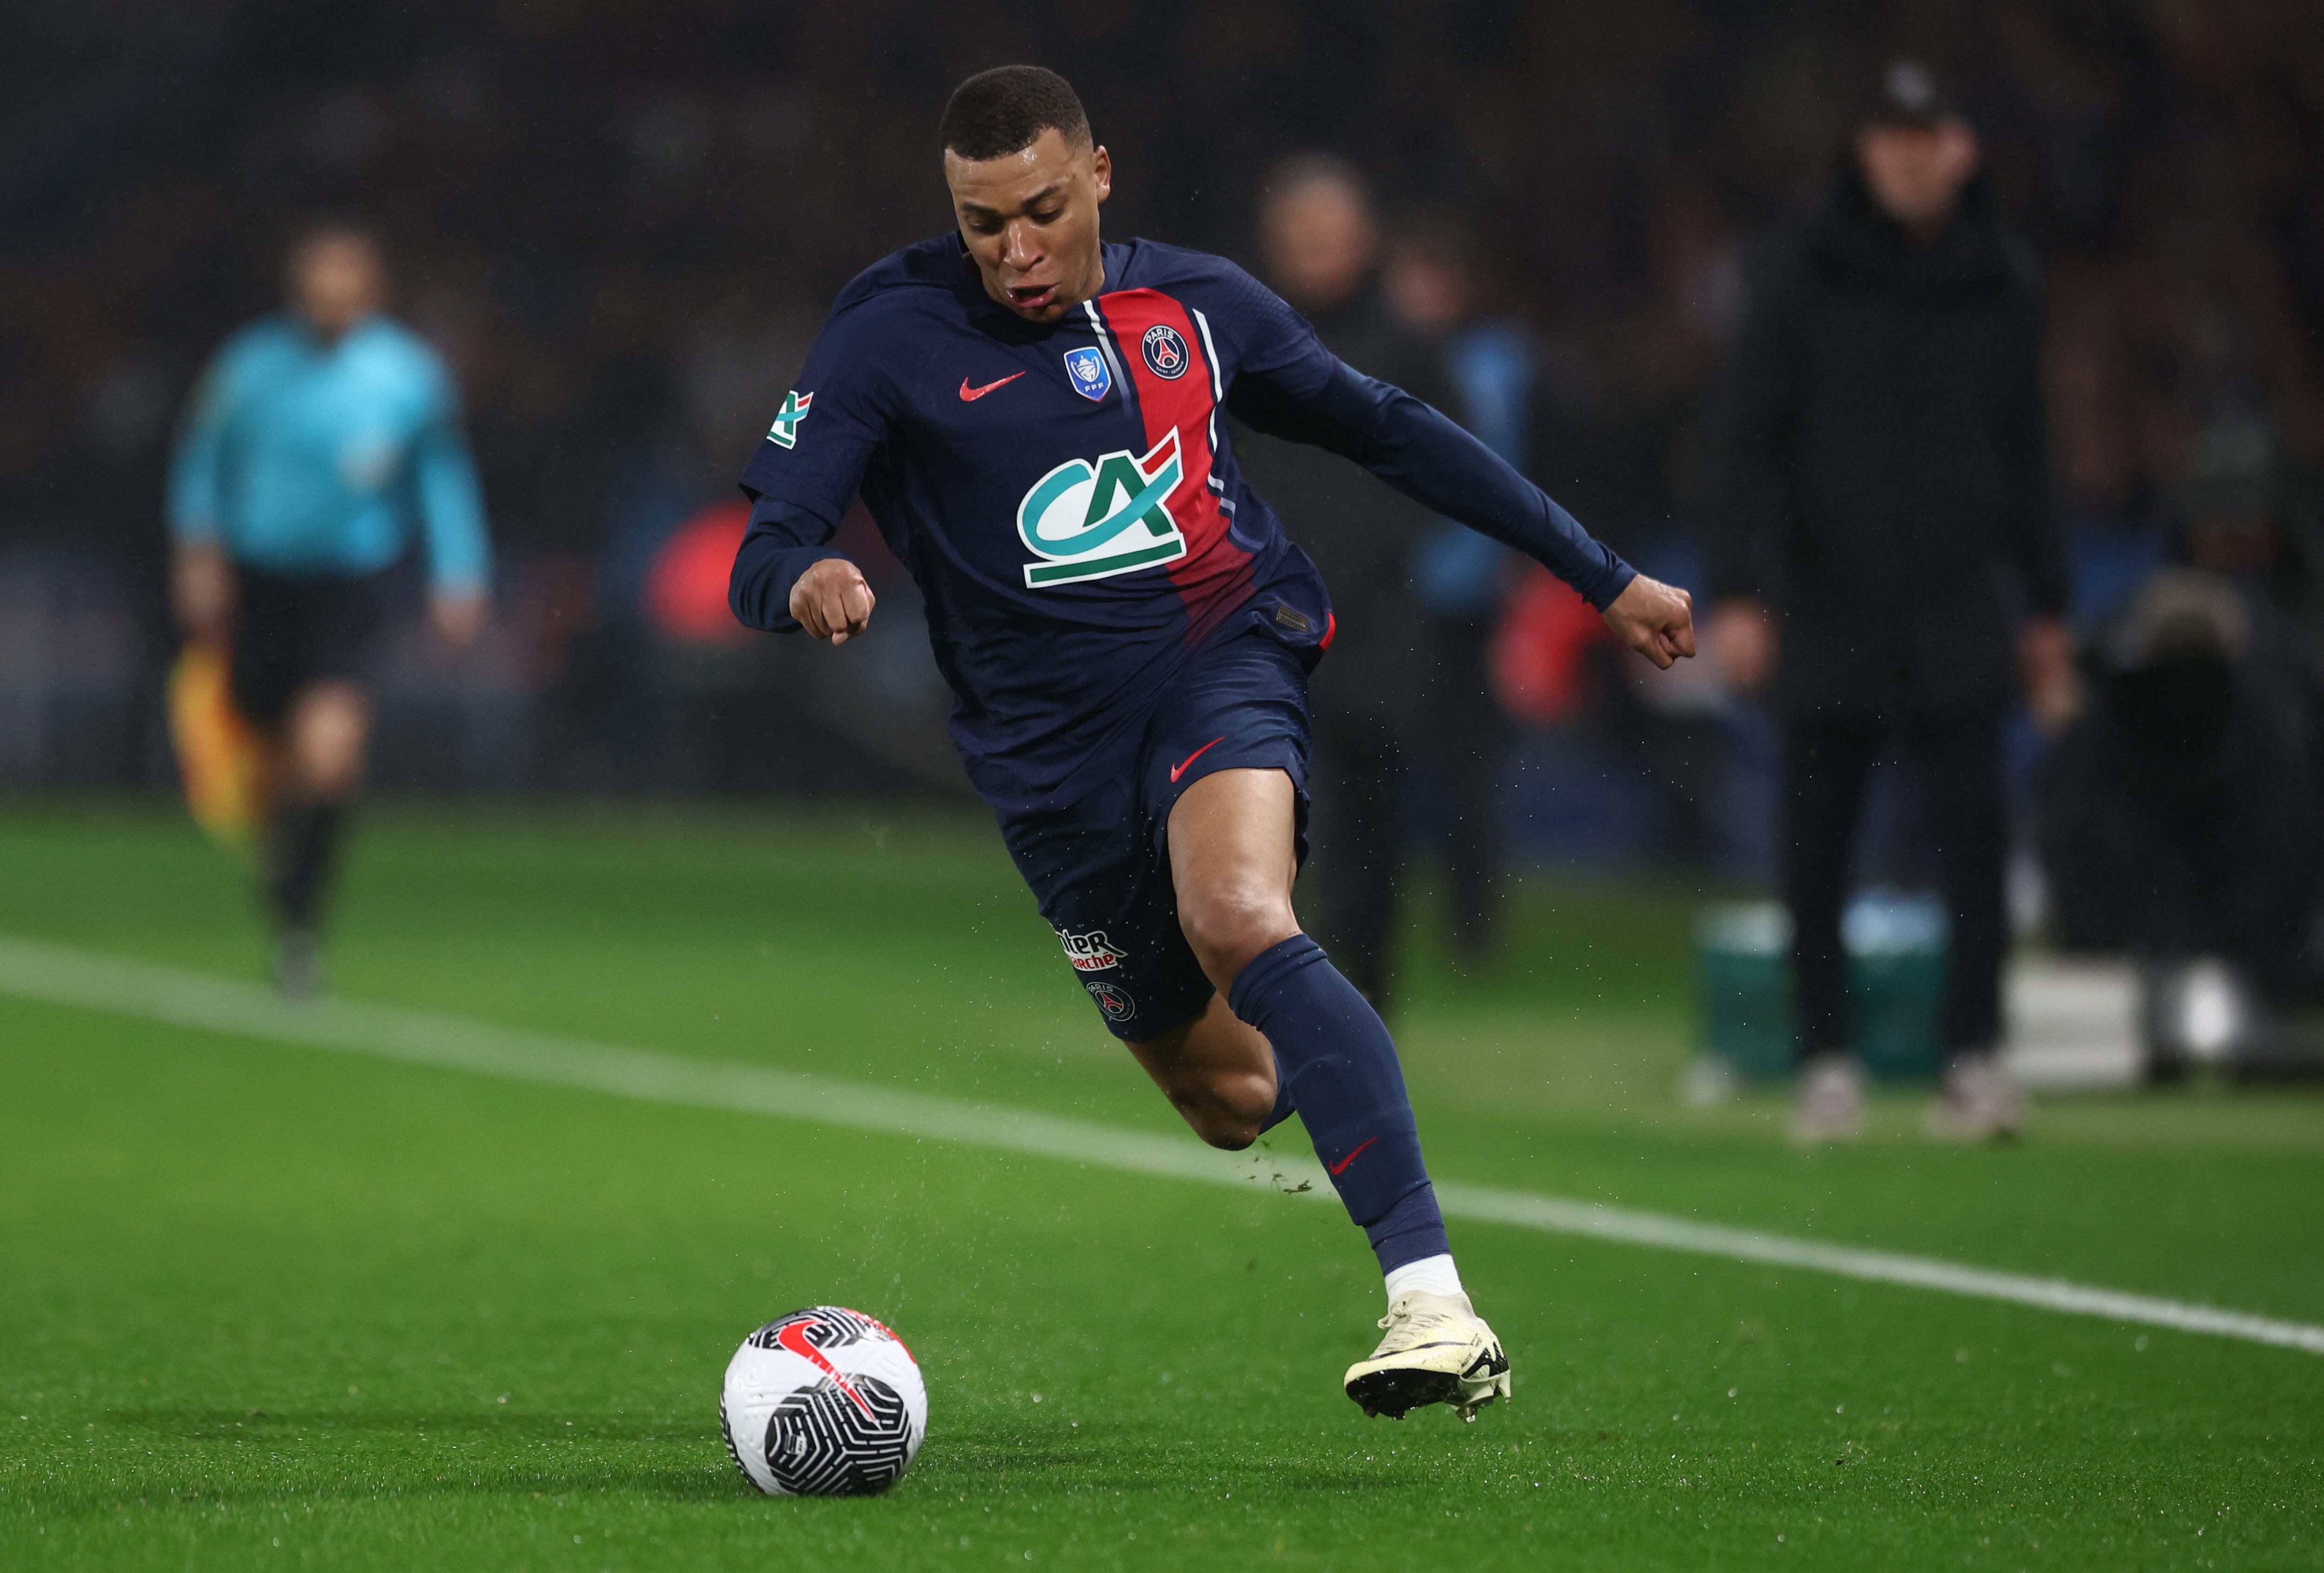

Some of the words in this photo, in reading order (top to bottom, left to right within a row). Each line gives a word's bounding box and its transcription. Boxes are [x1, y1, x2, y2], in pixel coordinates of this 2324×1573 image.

[1146, 328, 1174, 344] PARIS
[1084, 382, 1104, 392] FFF
[1088, 984, 1114, 994] PARIS
